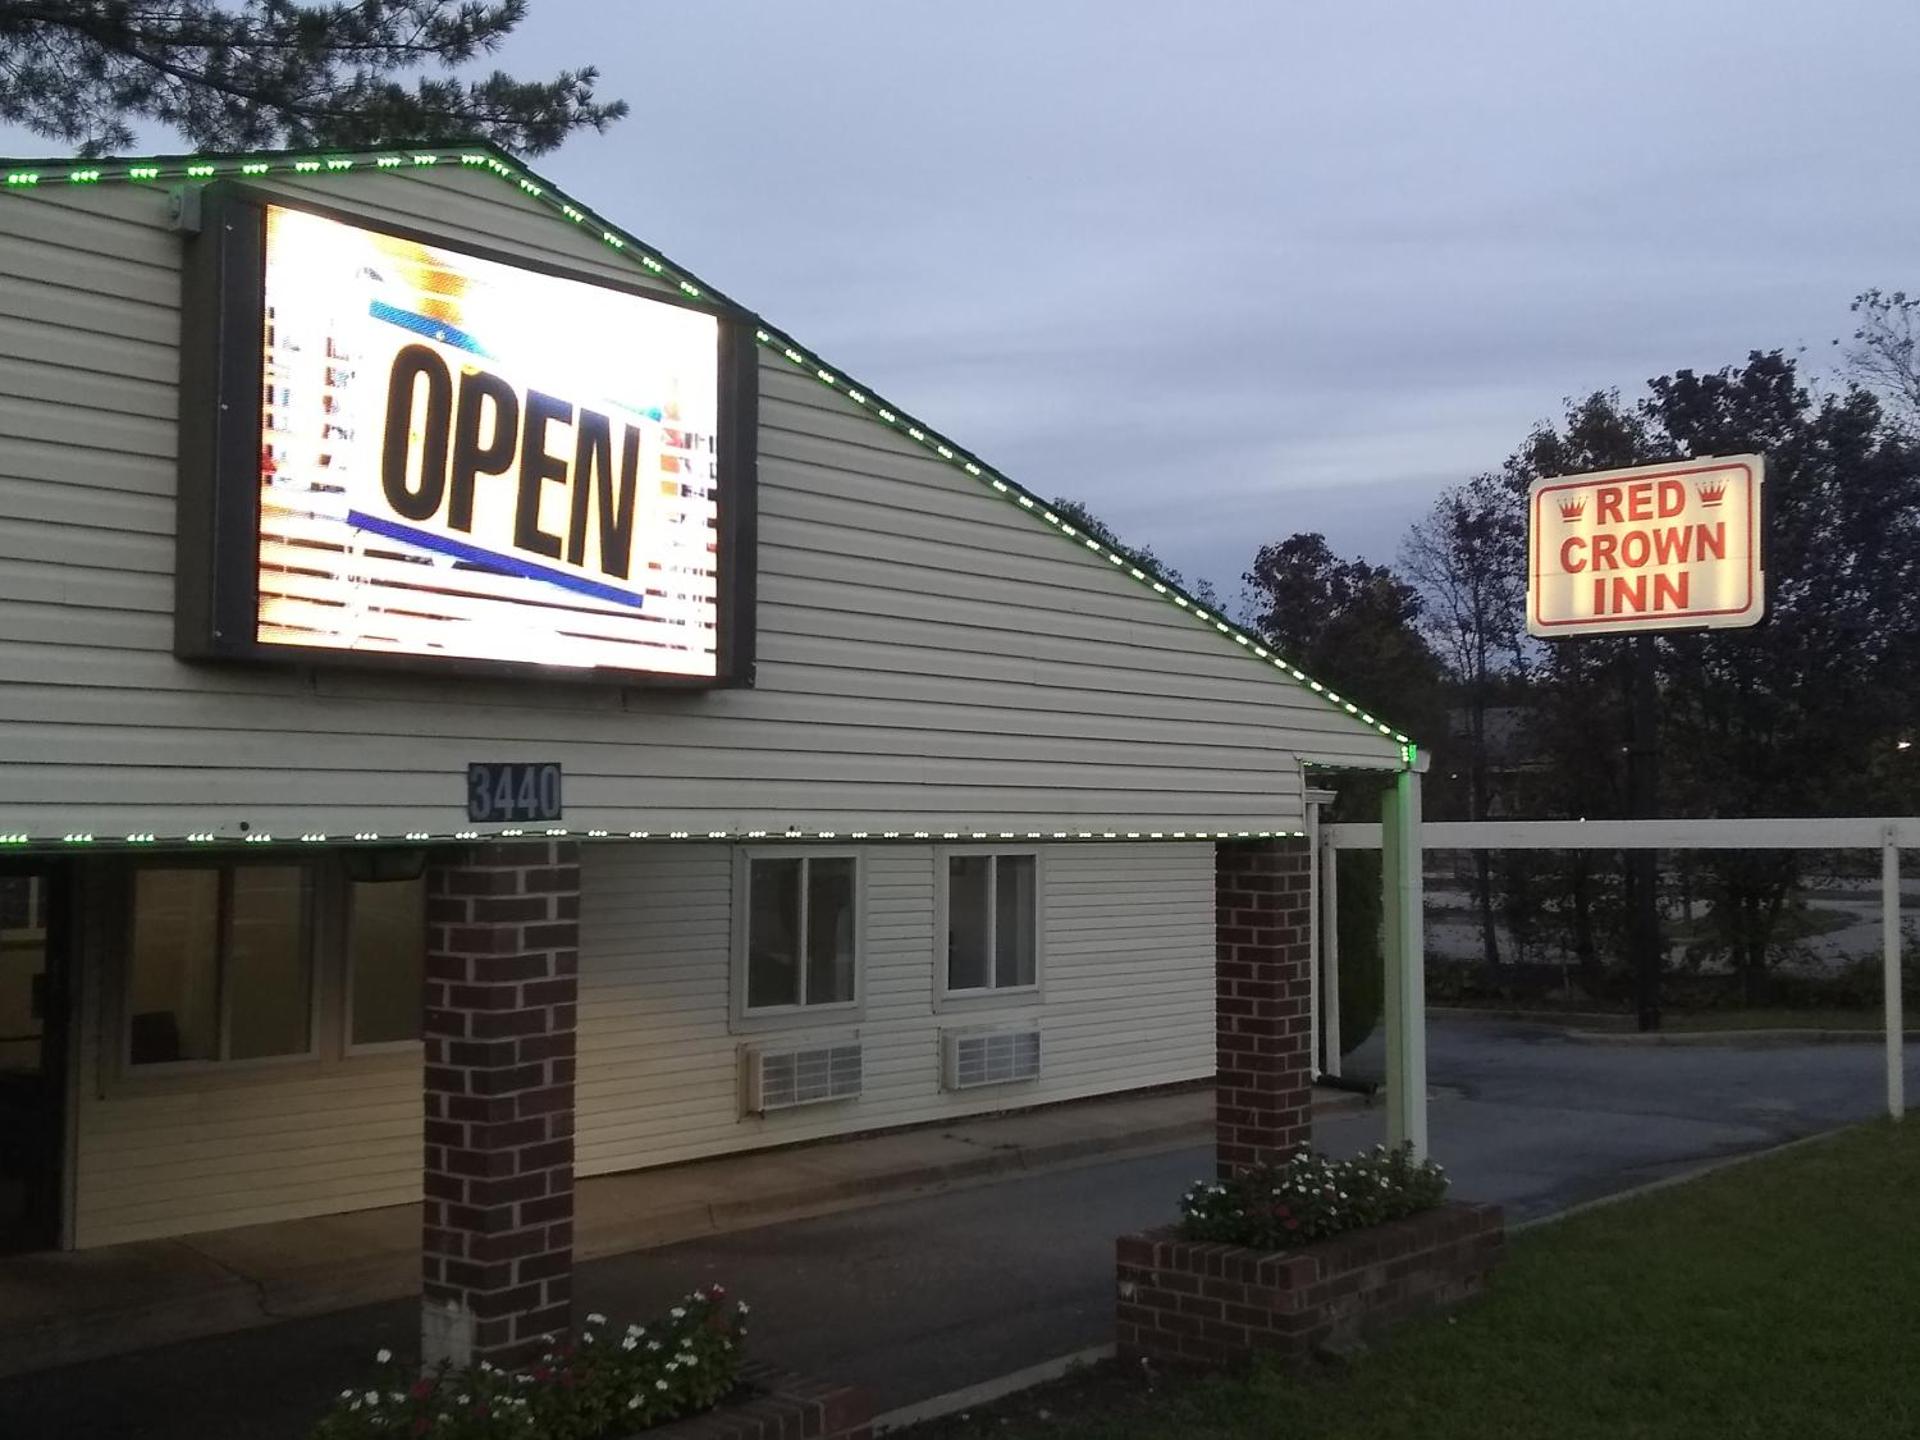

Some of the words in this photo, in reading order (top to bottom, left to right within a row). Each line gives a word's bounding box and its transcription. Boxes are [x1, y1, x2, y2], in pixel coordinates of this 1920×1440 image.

[381, 343, 641, 581] OPEN
[1596, 479, 1686, 525] RED
[1560, 521, 1726, 574] CROWN
[1594, 571, 1689, 615] INN
[470, 765, 560, 819] 3440
